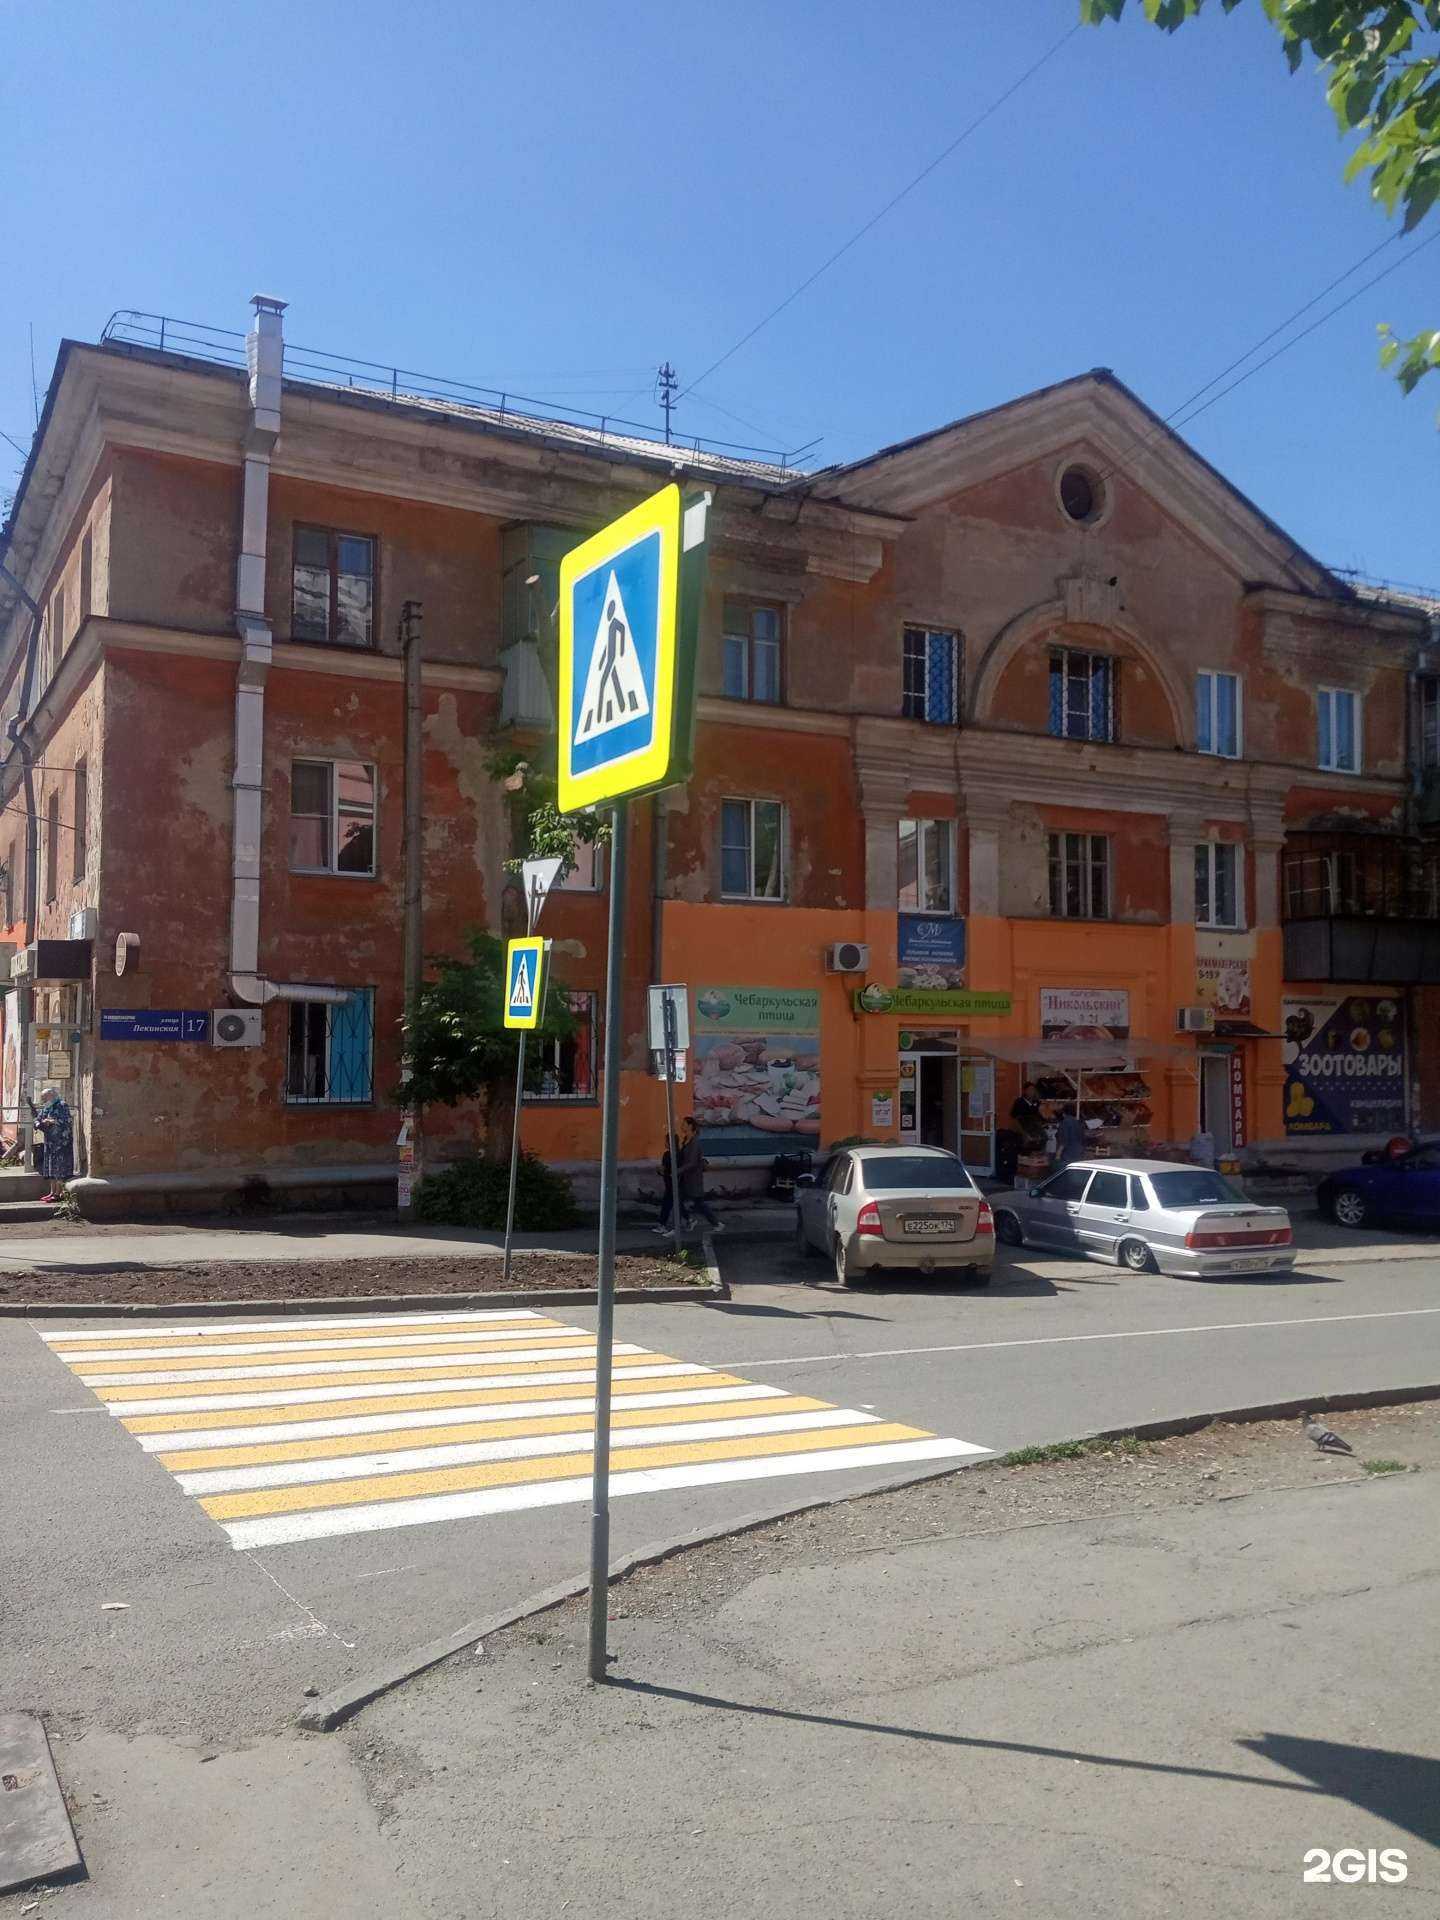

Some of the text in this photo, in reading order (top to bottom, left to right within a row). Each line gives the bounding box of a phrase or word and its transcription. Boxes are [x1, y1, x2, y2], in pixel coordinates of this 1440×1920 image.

[734, 993, 817, 1009] Чебаркульская
[974, 1000, 1010, 1009] птица
[759, 1010, 795, 1021] птица
[133, 1019, 205, 1032] Пекинская 17
[1298, 1054, 1402, 1077] ЗООТОВАРЫ
